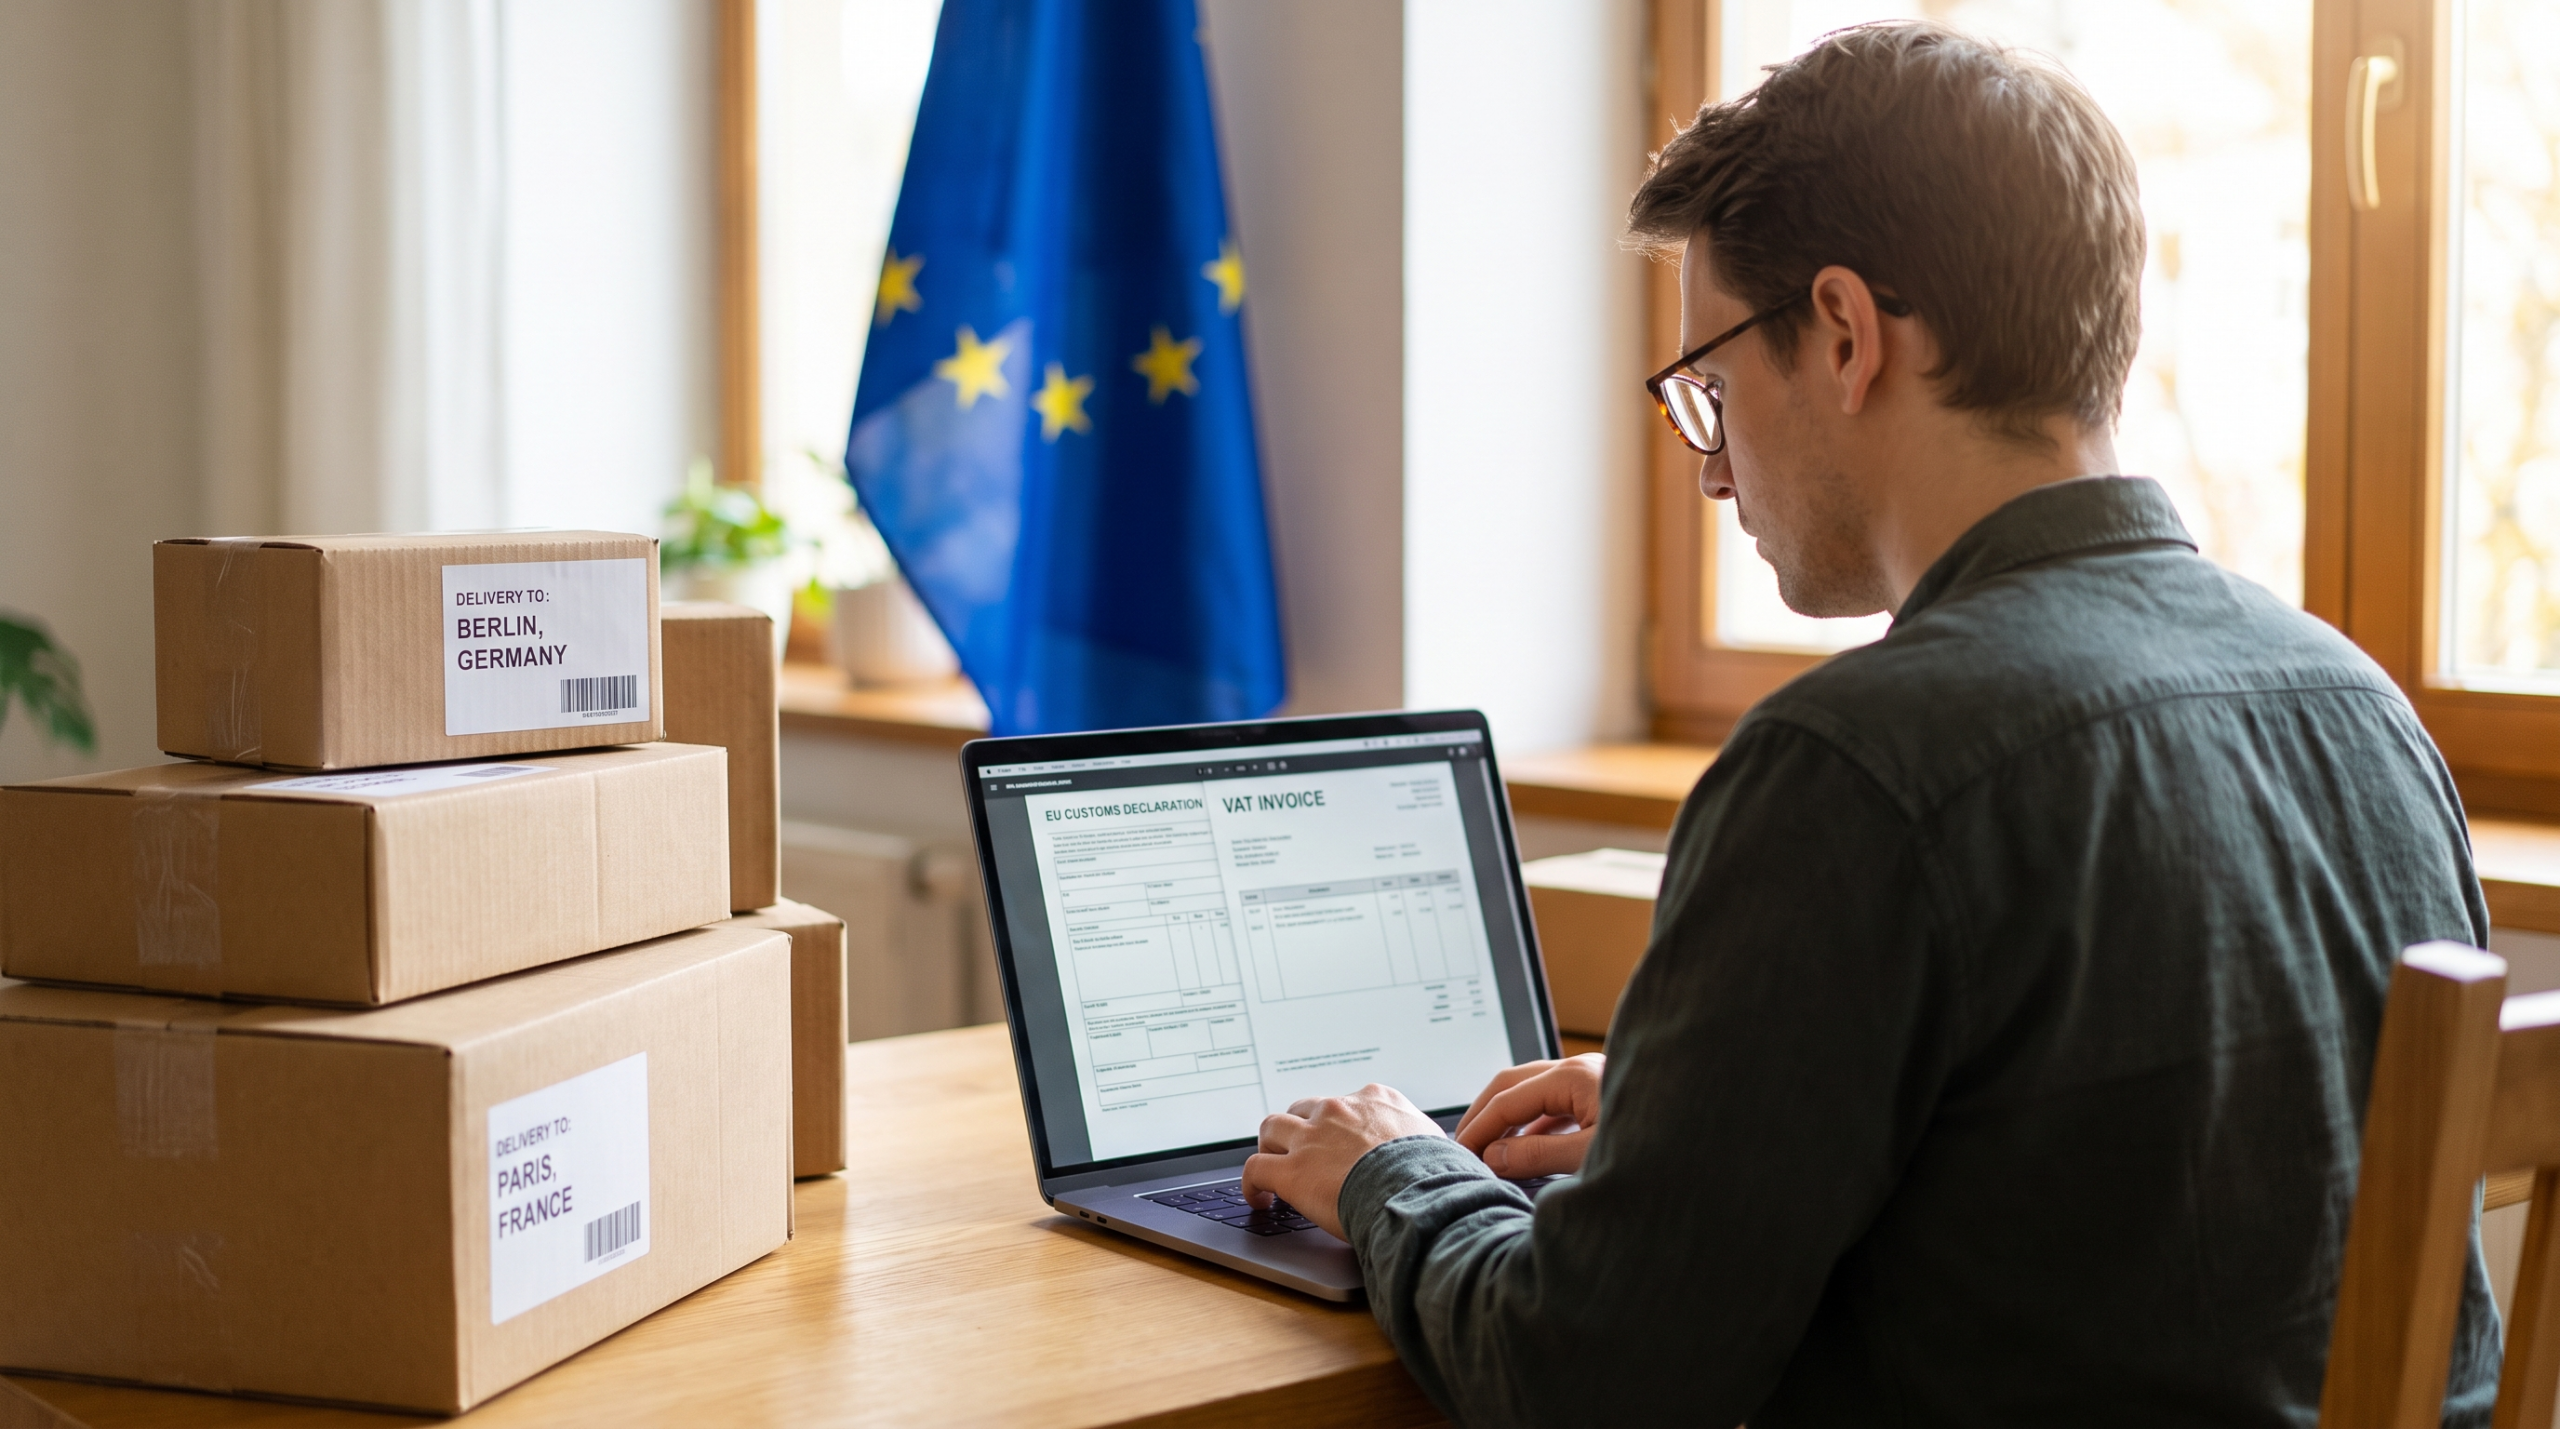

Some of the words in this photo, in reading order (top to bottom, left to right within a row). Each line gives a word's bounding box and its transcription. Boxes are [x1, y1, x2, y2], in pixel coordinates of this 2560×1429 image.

[456, 590, 523, 606] DELIVERY
[527, 589, 550, 603] TO:
[457, 615, 544, 639] BERLIN,
[457, 644, 567, 671] GERMANY
[1046, 809, 1062, 822] EU
[1065, 804, 1121, 821] CUSTOMS
[1123, 798, 1203, 816] DECLARATION
[1222, 795, 1253, 814] VAT
[1258, 790, 1326, 811] INVOICE
[496, 1122, 551, 1158] DELIVERY
[554, 1116, 572, 1136] TO:
[497, 1154, 557, 1198] PARIS,
[498, 1185, 573, 1239] FRANCE
